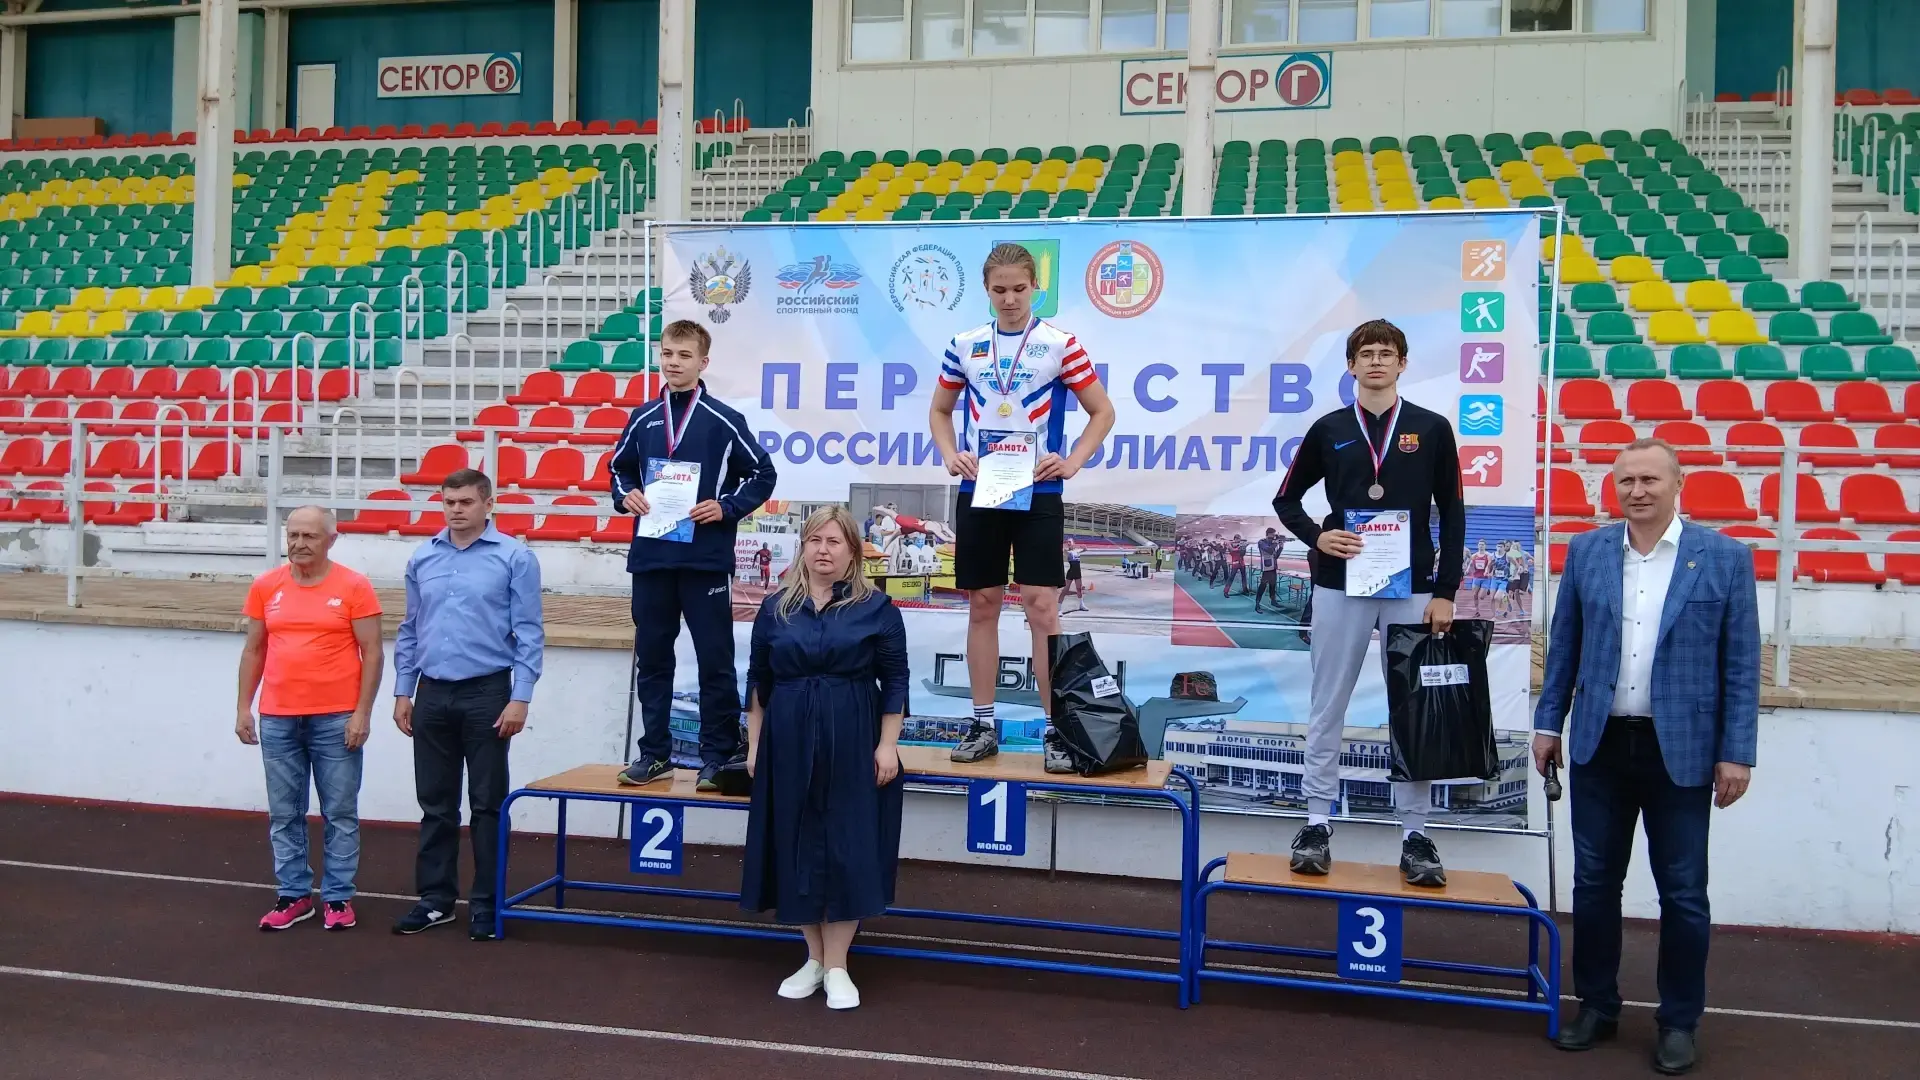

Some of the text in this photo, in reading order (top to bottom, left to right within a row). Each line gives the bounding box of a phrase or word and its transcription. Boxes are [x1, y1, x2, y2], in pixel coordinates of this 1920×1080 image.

[380, 64, 509, 92] СЕКТОР В
[1126, 69, 1308, 106] СЕКОР Г
[912, 244, 957, 262] ФЕДЕРАЦИЯ
[946, 260, 966, 311] ПОЛИАТЛОНА
[776, 294, 859, 306] РОССИЙСКИЙ
[776, 306, 832, 314] СПОРТИВНЫЙ
[758, 431, 943, 466] РОССИИ
[988, 443, 1028, 453] ГРАМОТА
[1355, 523, 1401, 532] ГРАМОТА
[1216, 735, 1296, 748] ДВОРЕЦ СПОРТА
[981, 782, 1007, 842] 1
[639, 808, 673, 860] 2
[977, 842, 1013, 851] MONDO
[640, 861, 672, 869] MONDO
[1352, 907, 1387, 958] 3
